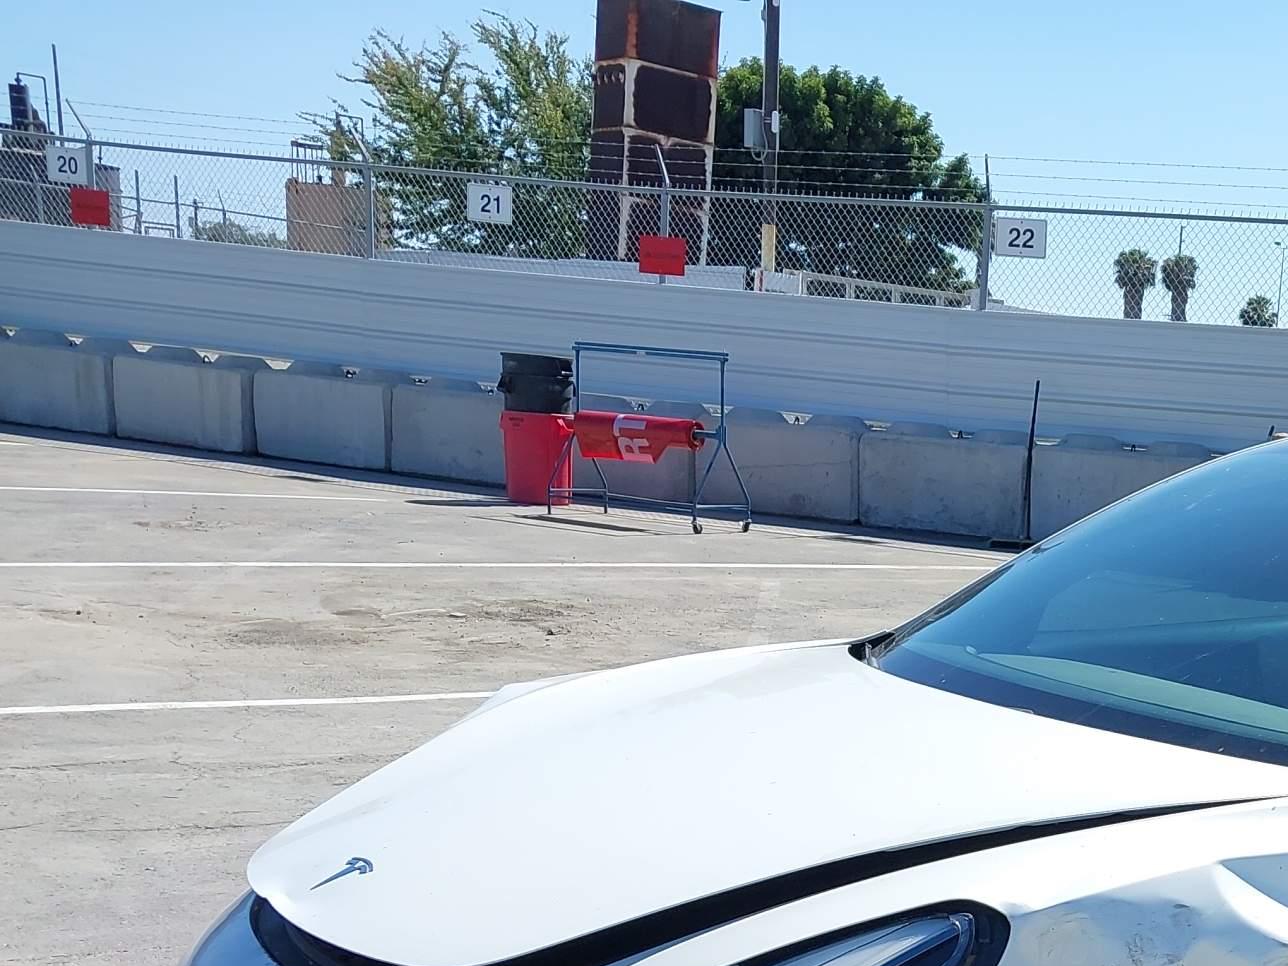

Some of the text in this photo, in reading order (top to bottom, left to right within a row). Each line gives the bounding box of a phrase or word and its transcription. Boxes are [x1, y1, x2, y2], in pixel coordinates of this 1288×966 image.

[57, 155, 77, 175] 20
[480, 194, 501, 216] 21
[1008, 227, 1035, 249] 22
